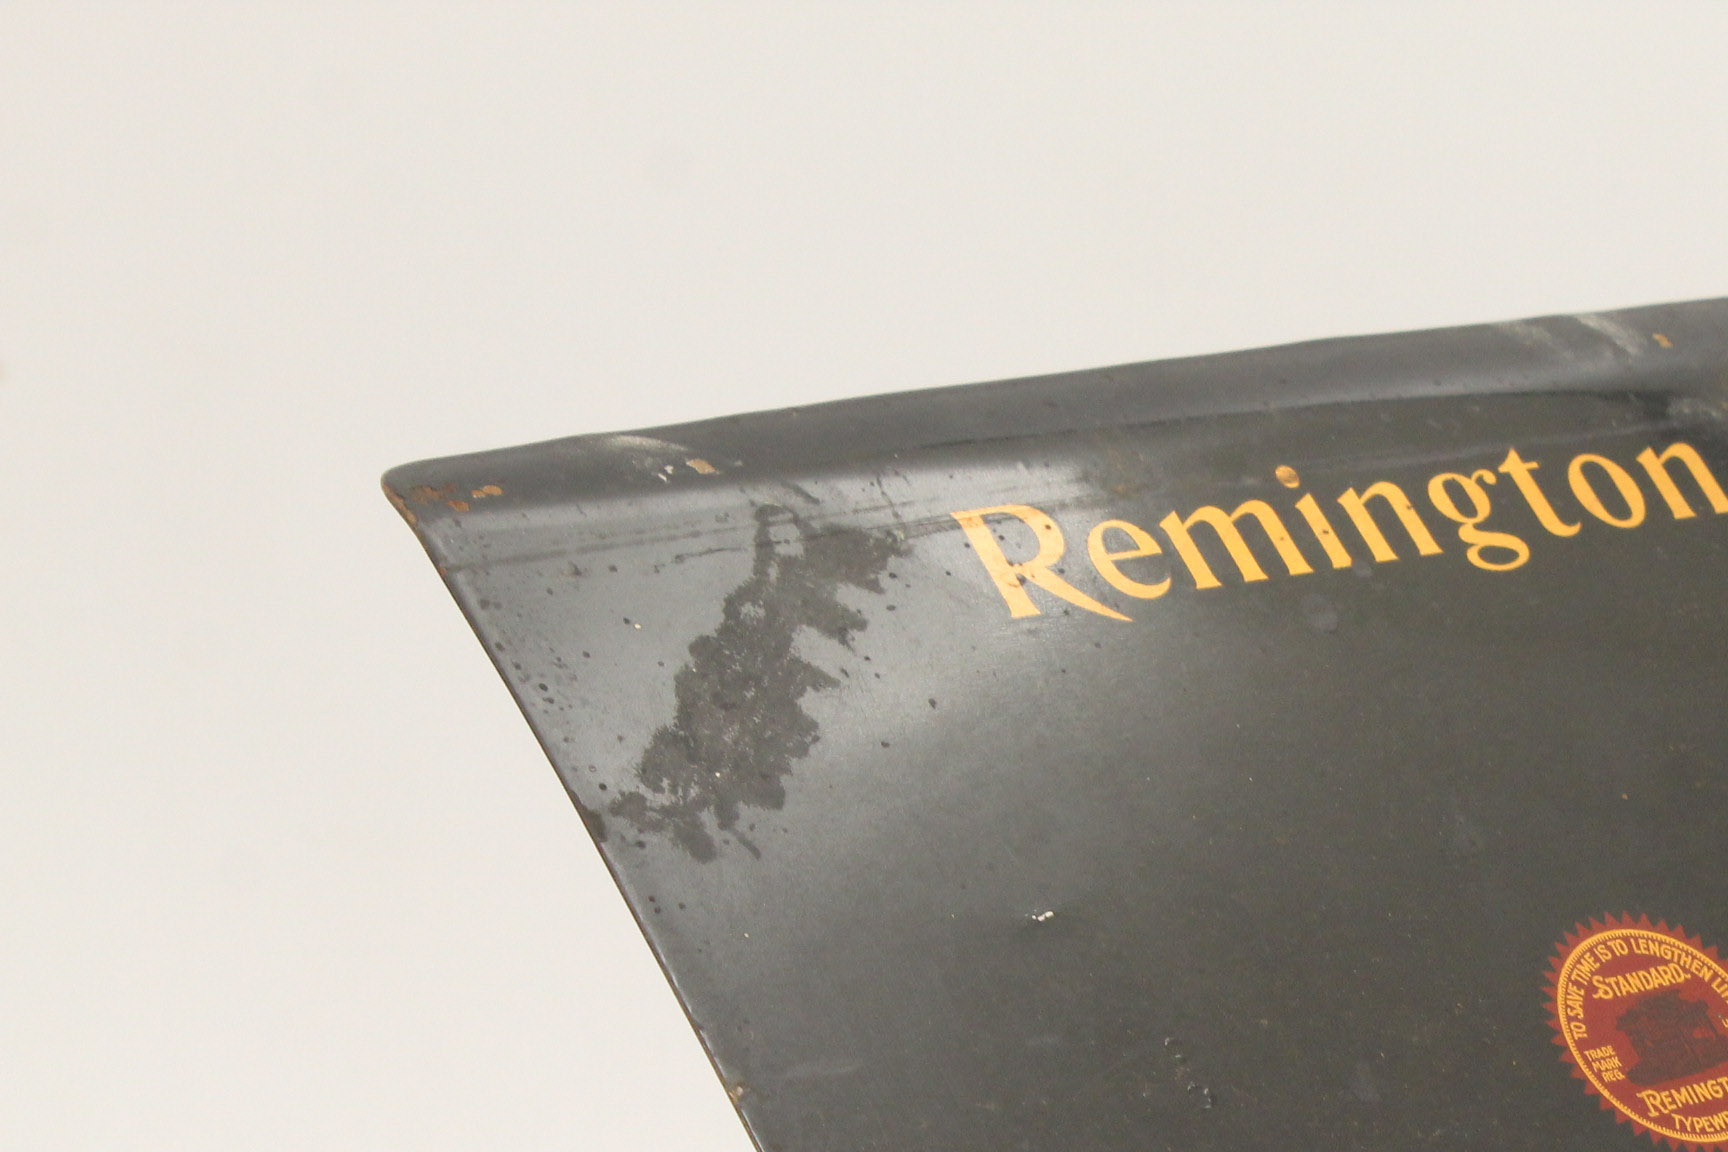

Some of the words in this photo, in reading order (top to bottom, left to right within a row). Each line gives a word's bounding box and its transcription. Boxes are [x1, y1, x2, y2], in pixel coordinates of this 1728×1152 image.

[1594, 942, 1612, 963] IS
[1608, 939, 1628, 957] TO
[1571, 954, 1600, 984] TIME
[1630, 938, 1714, 982] LENGTHEN
[1566, 985, 1585, 1019] SAVE
[1570, 1022, 1588, 1040] TO
[1584, 1045, 1616, 1061] TRADE
[1591, 1056, 1622, 1073] MARK
